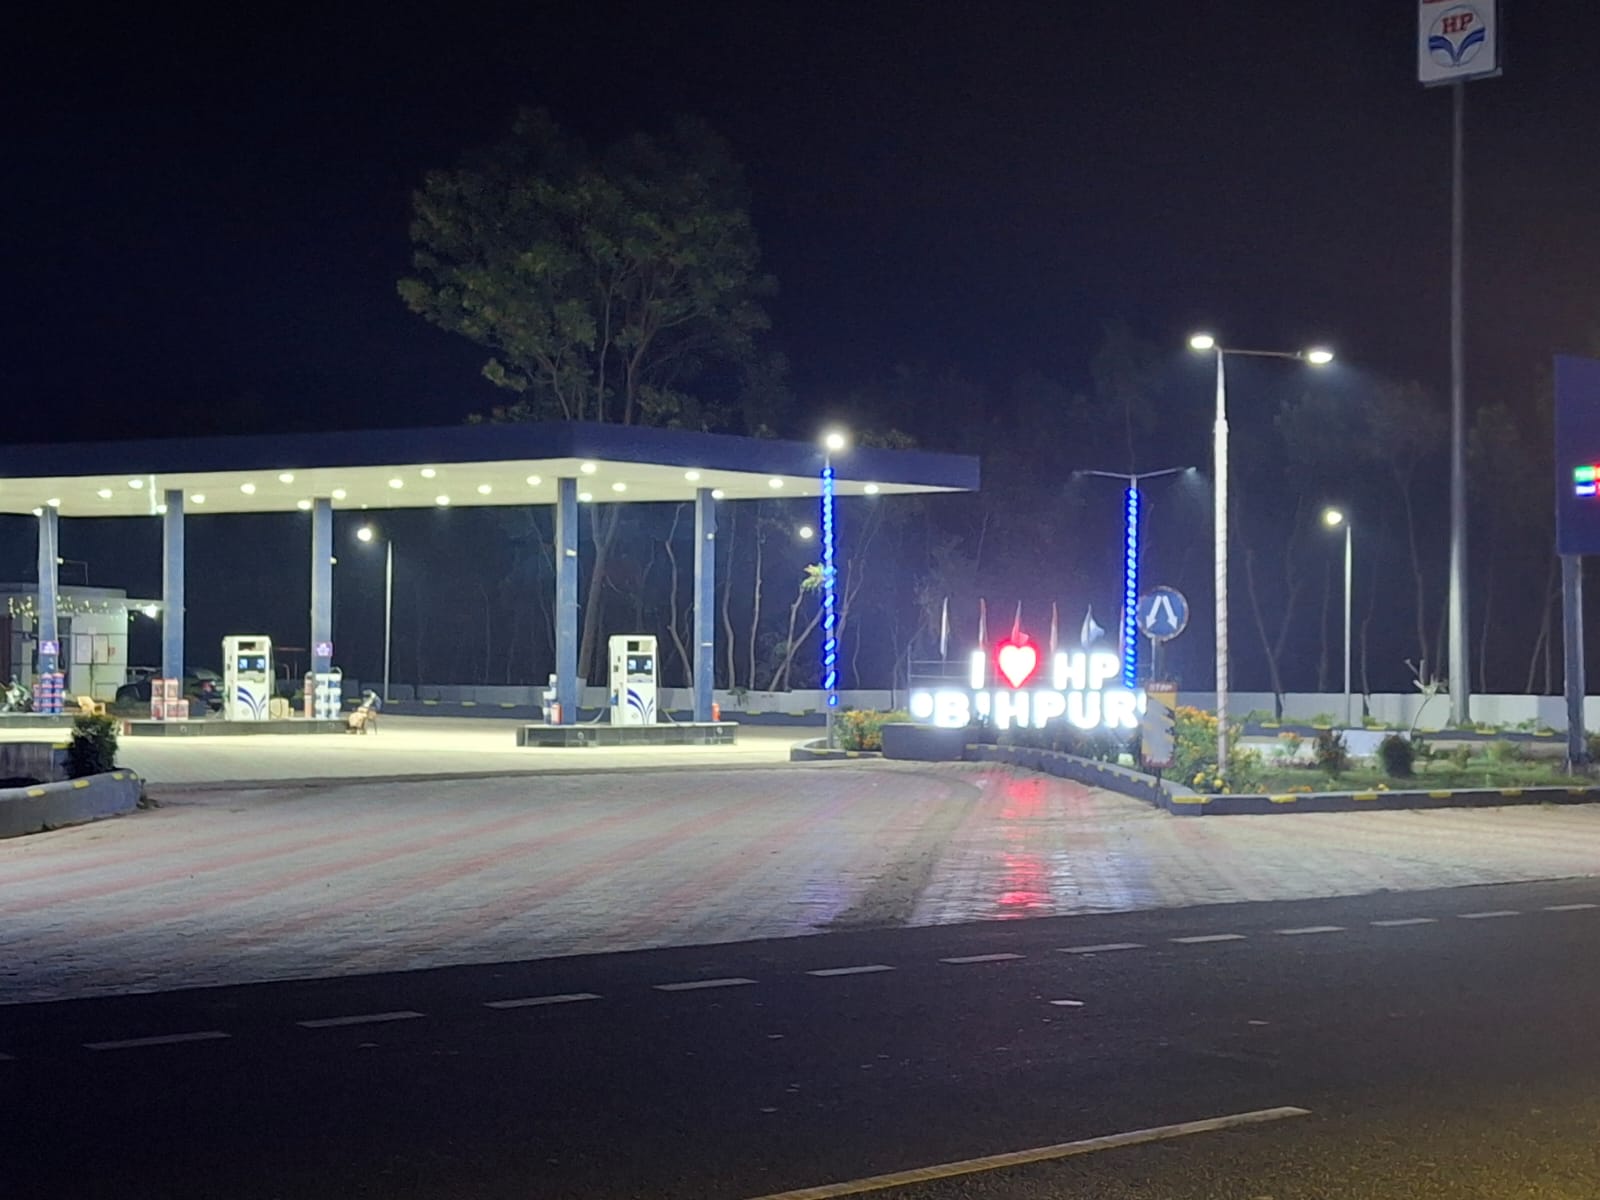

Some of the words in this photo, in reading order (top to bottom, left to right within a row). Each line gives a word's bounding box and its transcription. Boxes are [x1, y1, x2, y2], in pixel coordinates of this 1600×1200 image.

[1441, 12, 1474, 34] HP
[970, 650, 986, 690] I
[1053, 651, 1120, 690] HP
